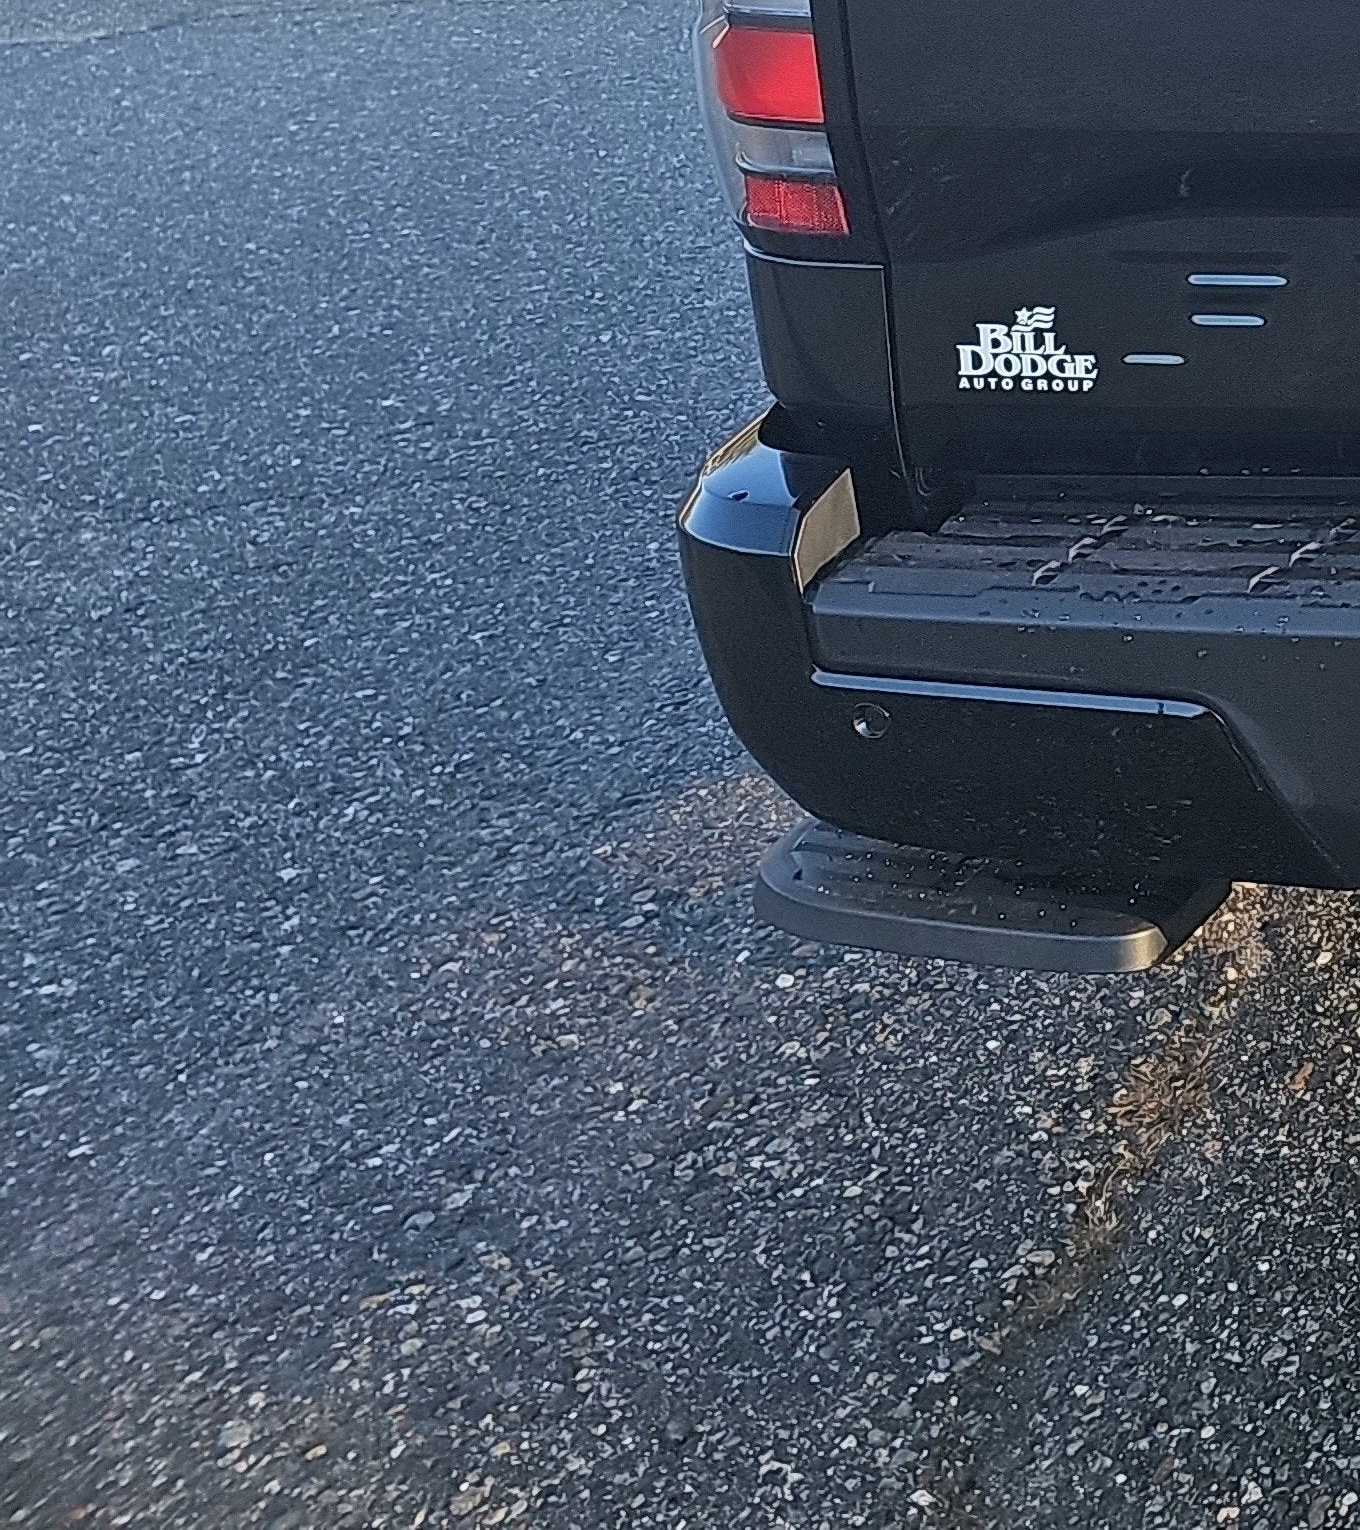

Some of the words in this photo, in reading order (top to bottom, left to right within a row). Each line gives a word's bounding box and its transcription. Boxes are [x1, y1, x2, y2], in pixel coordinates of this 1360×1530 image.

[975, 323, 1067, 355] BILL
[955, 344, 1099, 379] DODGE
[958, 377, 1014, 391] AUTO
[1020, 378, 1094, 392] GROUP
